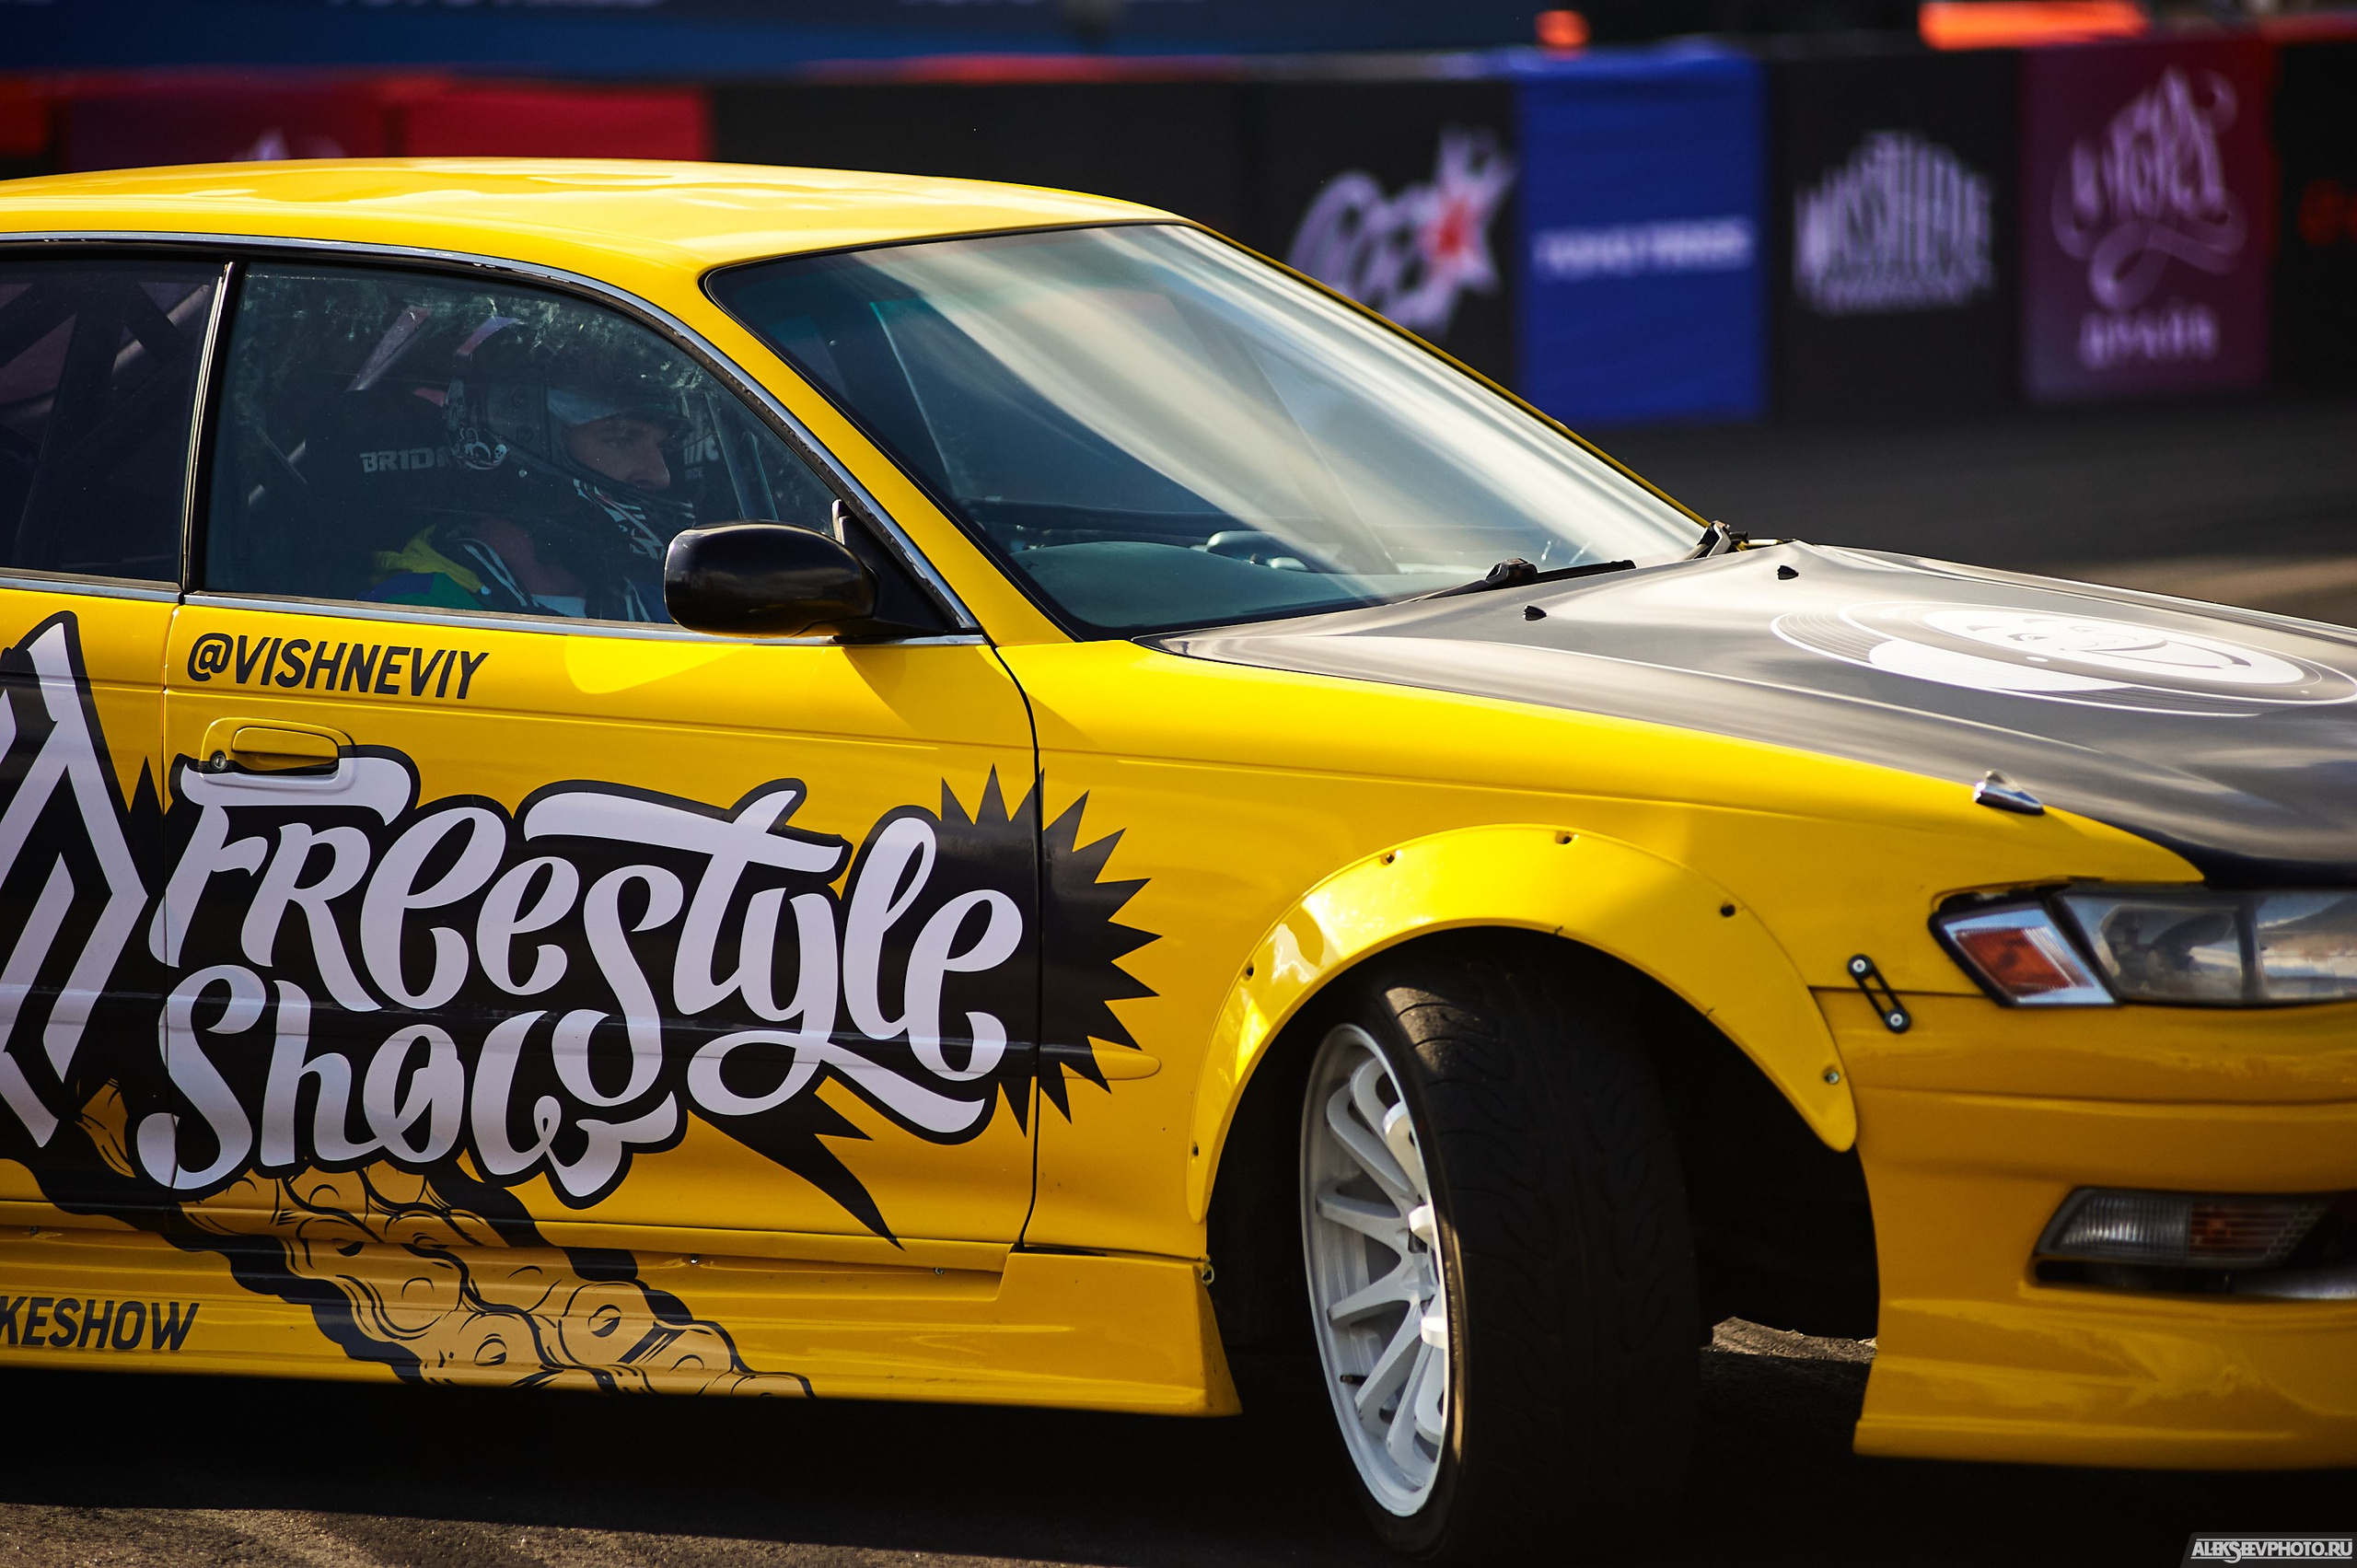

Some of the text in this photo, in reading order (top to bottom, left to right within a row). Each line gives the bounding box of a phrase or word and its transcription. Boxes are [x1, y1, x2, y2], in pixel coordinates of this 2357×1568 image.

[188, 633, 489, 699] @VISHNEVIY
[137, 965, 678, 1199] Show
[0, 1295, 200, 1350] KESHOW
